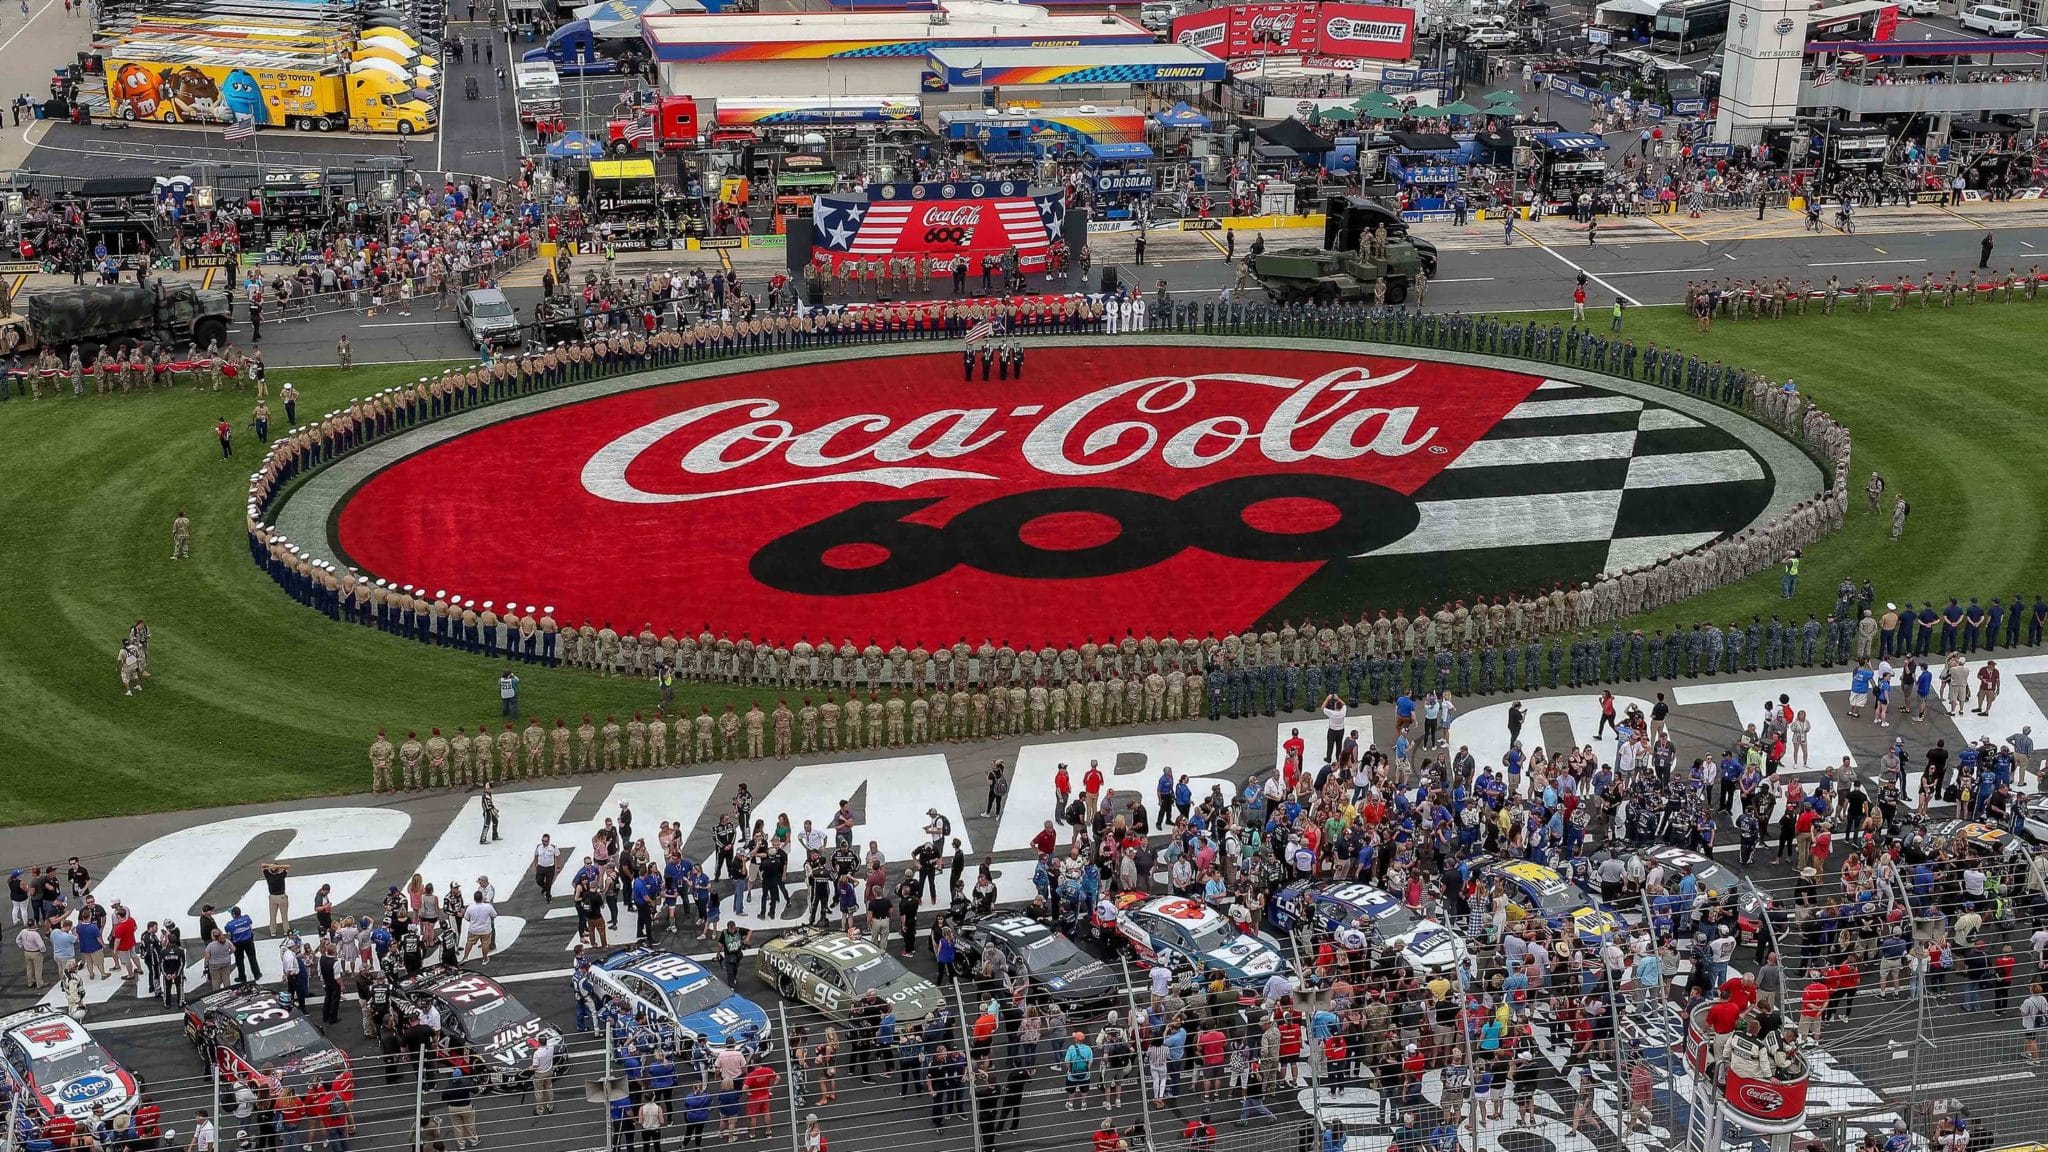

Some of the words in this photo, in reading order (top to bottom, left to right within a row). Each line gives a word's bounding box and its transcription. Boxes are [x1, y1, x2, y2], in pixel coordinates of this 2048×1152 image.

[1251, 12, 1299, 31] Coca-Cola
[1193, 25, 1224, 41] CHARLOTTE
[1352, 22, 1403, 36] CHARLOTTE
[1242, 60, 1257, 70] 600
[1306, 56, 1333, 66] Coca-Cola
[1333, 59, 1354, 68] 600
[288, 74, 315, 82] TOYOTA
[1155, 67, 1205, 78] SUNOCO
[299, 85, 312, 97] 18
[880, 106, 917, 116] SUNOCO
[1556, 138, 1596, 147] Lite
[265, 173, 293, 182] CAT
[1113, 177, 1124, 188] DC
[1125, 176, 1152, 187] SOLAR
[1414, 174, 1450, 183] ClickList
[600, 199, 613, 210] 21
[1541, 205, 1559, 215] Lite
[922, 205, 983, 227] Coca-Cola
[1087, 224, 1097, 232] DC
[1097, 223, 1121, 231] SOLAR
[1184, 221, 1205, 229] BUCKLE
[924, 227, 964, 246] 600
[580, 242, 596, 254] 21
[191, 258, 216, 267] CKLE
[580, 364, 1439, 504] Coca-Cola
[749, 473, 1421, 596] 600
[1334, 884, 1389, 906] 48
[988, 916, 1050, 938] 15
[639, 956, 700, 981] 88
[763, 951, 810, 984] THORNE
[440, 977, 502, 1002] 14
[813, 983, 841, 1010] 95
[235, 999, 290, 1026] 34
[484, 1016, 542, 1051] HAAS
[222, 1050, 238, 1077] 34
[64, 1079, 109, 1100] Kroger
[1746, 1087, 1777, 1101] Coca-Cola
[71, 1094, 122, 1116] ClicList
